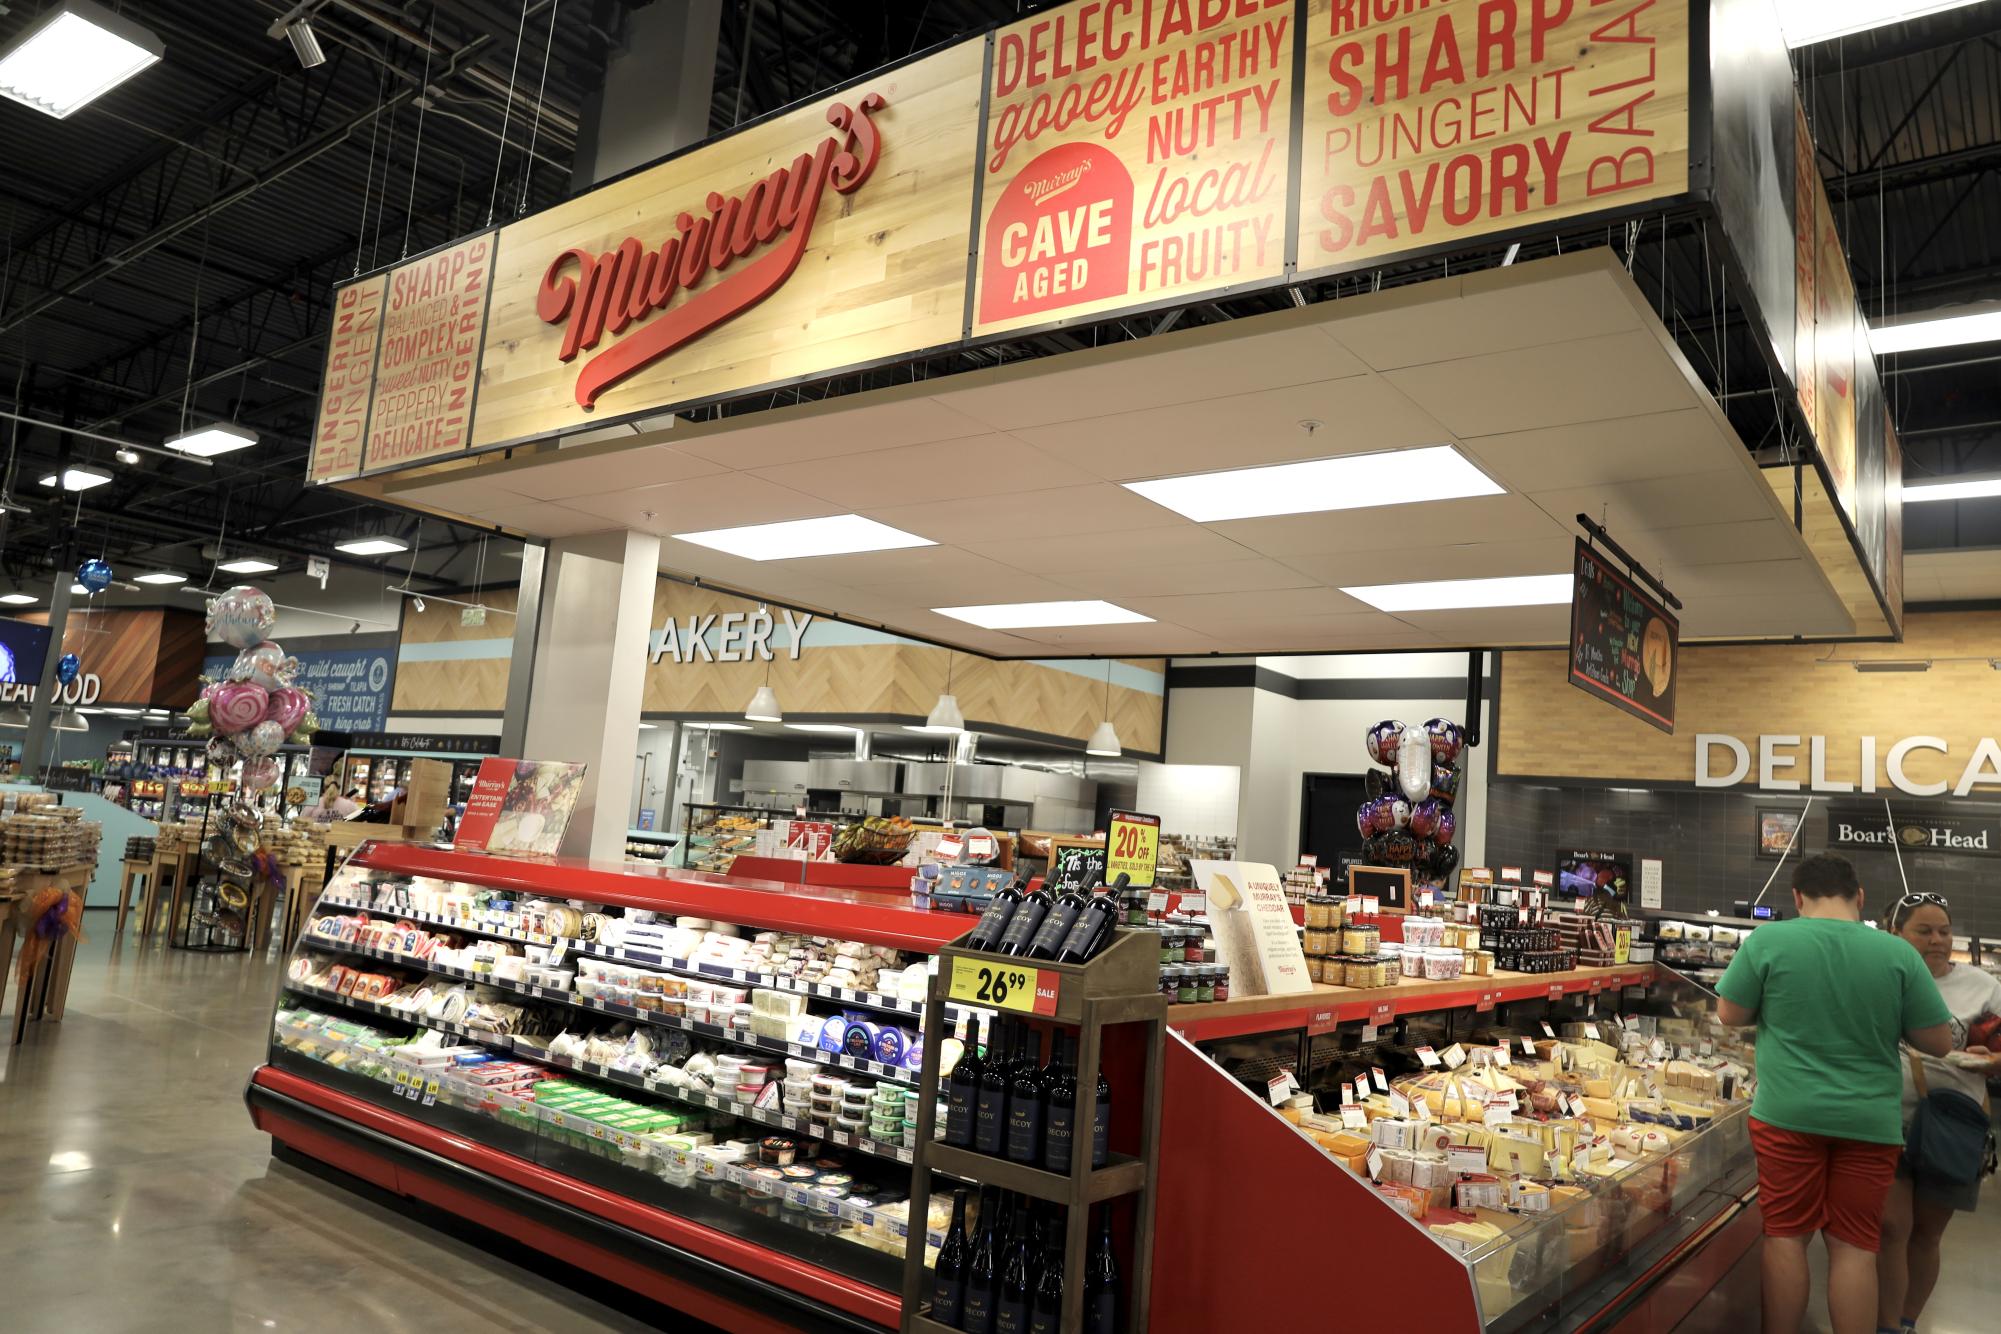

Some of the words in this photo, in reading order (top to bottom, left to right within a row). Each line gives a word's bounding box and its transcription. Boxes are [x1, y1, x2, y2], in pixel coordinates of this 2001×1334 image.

[996, 0, 1289, 98] DELECTA
[1150, 16, 1288, 106] EARTHY
[1328, 0, 1573, 117] SHARP
[989, 62, 1146, 173] gooey
[1147, 78, 1280, 164] NUTTY
[1324, 66, 1576, 176] PUNGENT
[1586, 0, 1656, 198] BALA
[1024, 158, 1092, 206] Murray's
[1143, 138, 1276, 229] local
[1319, 131, 1572, 253] SAVORY
[536, 92, 886, 408] Murray's
[1001, 198, 1114, 268] CAVE
[1138, 213, 1274, 292] FRUITY
[392, 251, 465, 311] SHARP
[1012, 258, 1089, 304] AGED
[383, 320, 457, 370] COMPLEX
[387, 300, 448, 337] BALANCED
[444, 241, 487, 448] LINGERING
[317, 288, 358, 474] LINGERING
[336, 286, 380, 469] PUNGENT
[375, 382, 449, 431] PEPPERY
[379, 364, 418, 396] sweet
[417, 357, 453, 387] NUTTY
[369, 416, 445, 463] DELICATE
[652, 609, 814, 664] AKERY
[328, 695, 351, 713] FRESH
[352, 694, 377, 712] CATCH
[1695, 734, 2001, 796] DELICA
[1086, 856, 1103, 871] the
[1114, 825, 1139, 859] 20
[1138, 846, 1150, 860] OFF
[1838, 823, 1897, 845] Boar's
[1929, 828, 1988, 850] Head
[1036, 987, 1055, 999] SALE
[950, 1104, 969, 1113] ECOY
